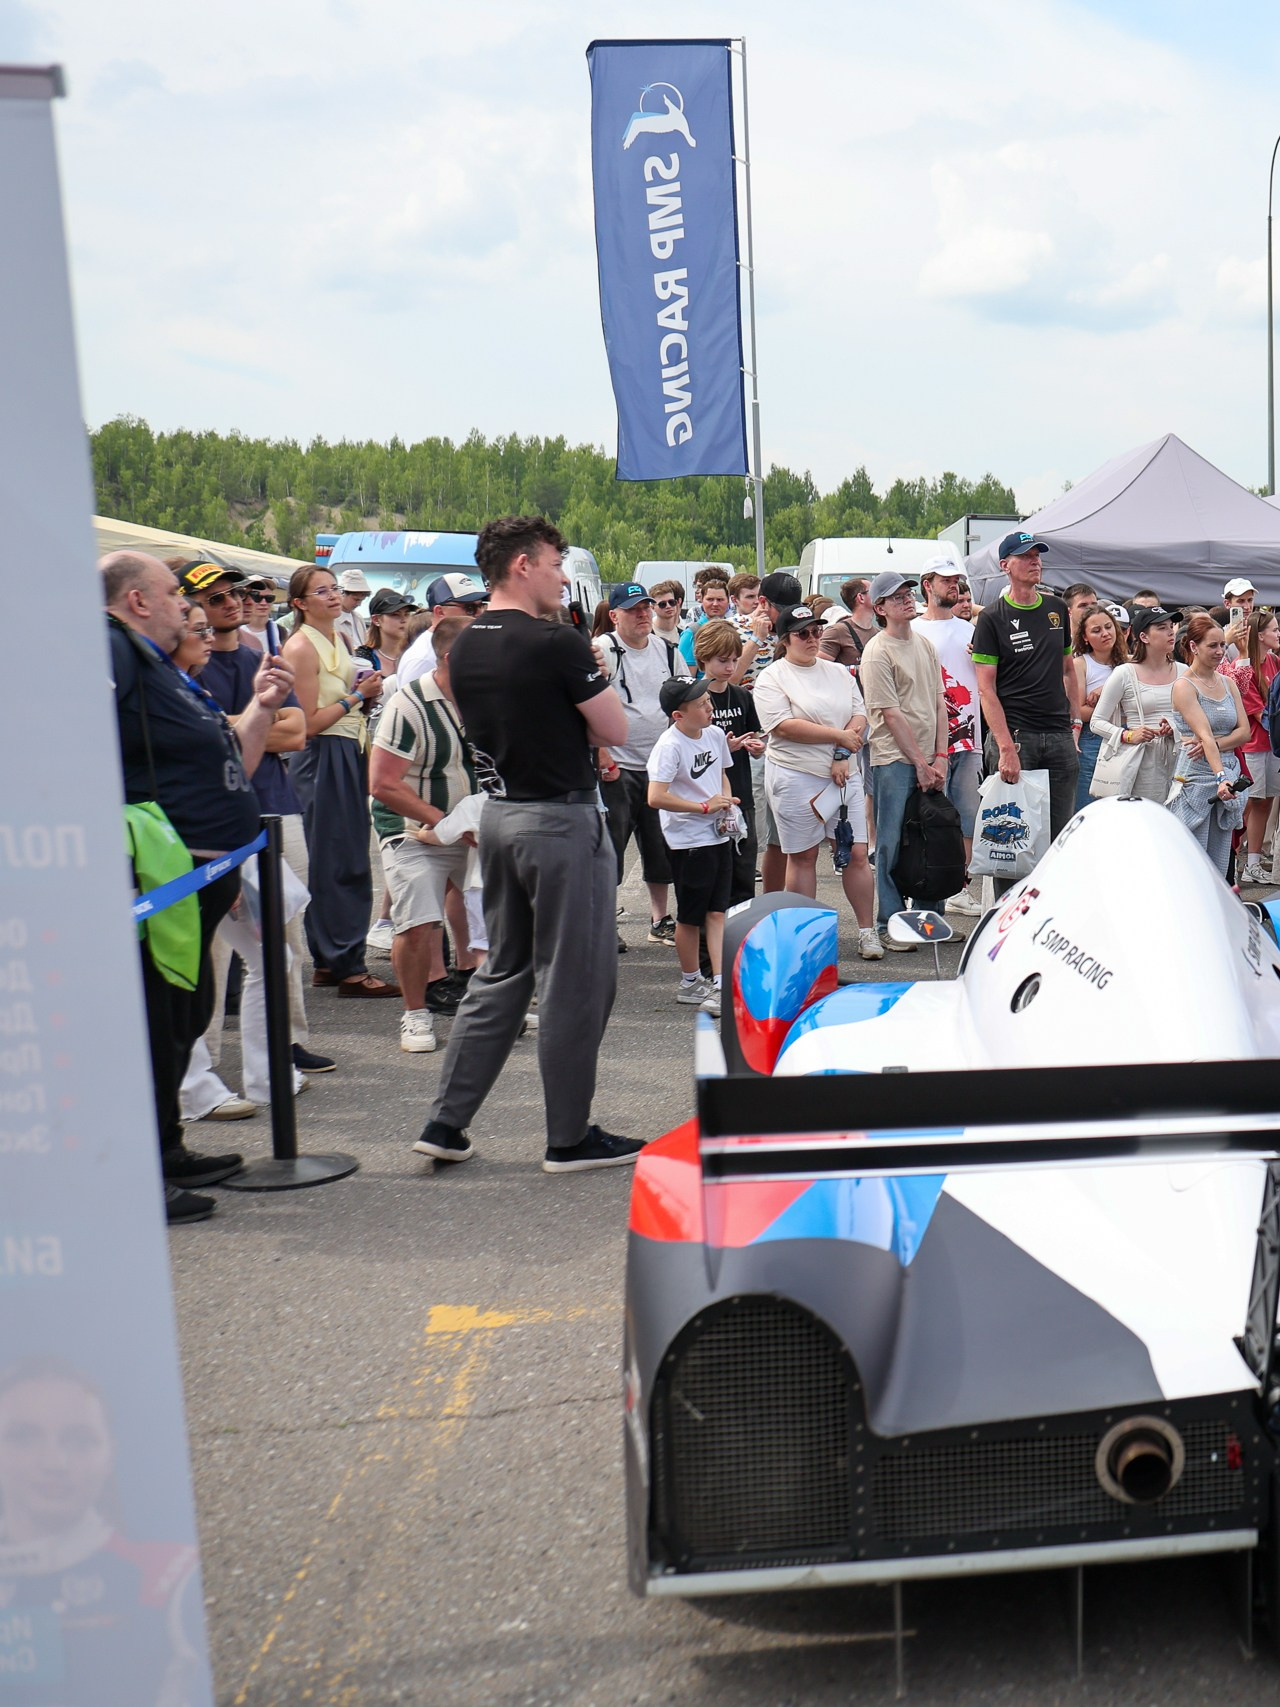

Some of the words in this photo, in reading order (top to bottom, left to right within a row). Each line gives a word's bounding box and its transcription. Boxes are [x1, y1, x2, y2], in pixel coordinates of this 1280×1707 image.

[694, 751, 712, 768] NIKE
[1041, 929, 1069, 955] SMP
[1062, 945, 1113, 990] RACING
